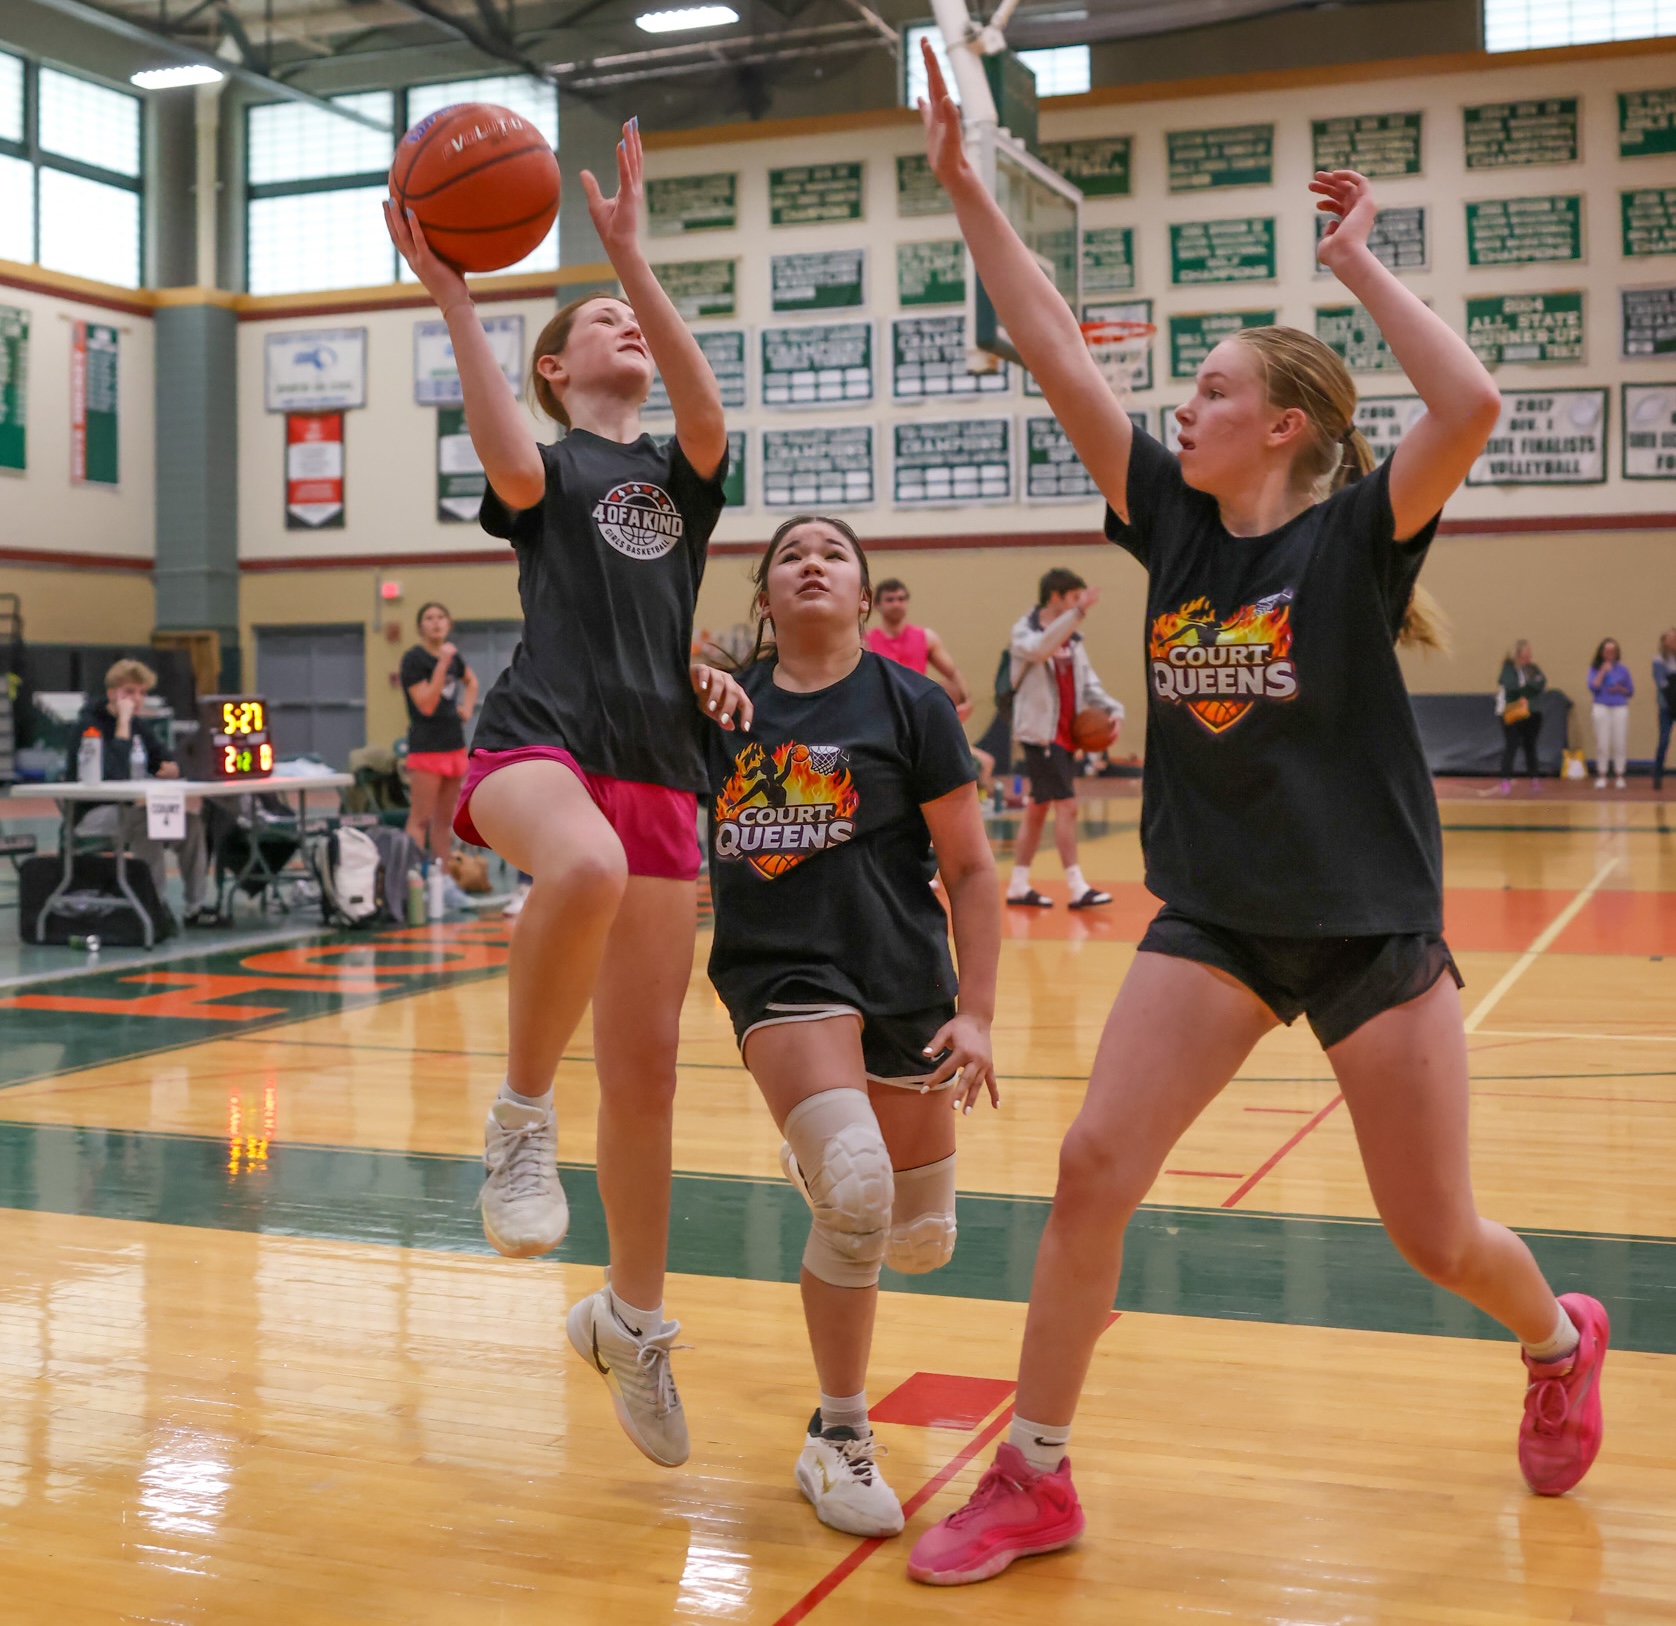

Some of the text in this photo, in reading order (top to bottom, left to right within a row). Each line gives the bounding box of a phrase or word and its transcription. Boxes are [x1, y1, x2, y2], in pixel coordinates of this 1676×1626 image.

[1490, 460, 1581, 475] VOLLEYBALL
[592, 503, 683, 537] 4 OF A KIND
[605, 528, 670, 556] GIRLS BASKETBALL
[1168, 645, 1269, 666] COURT
[1153, 661, 1297, 701] QUEENS
[738, 804, 834, 825] COURT
[715, 820, 854, 857] QUEENS
